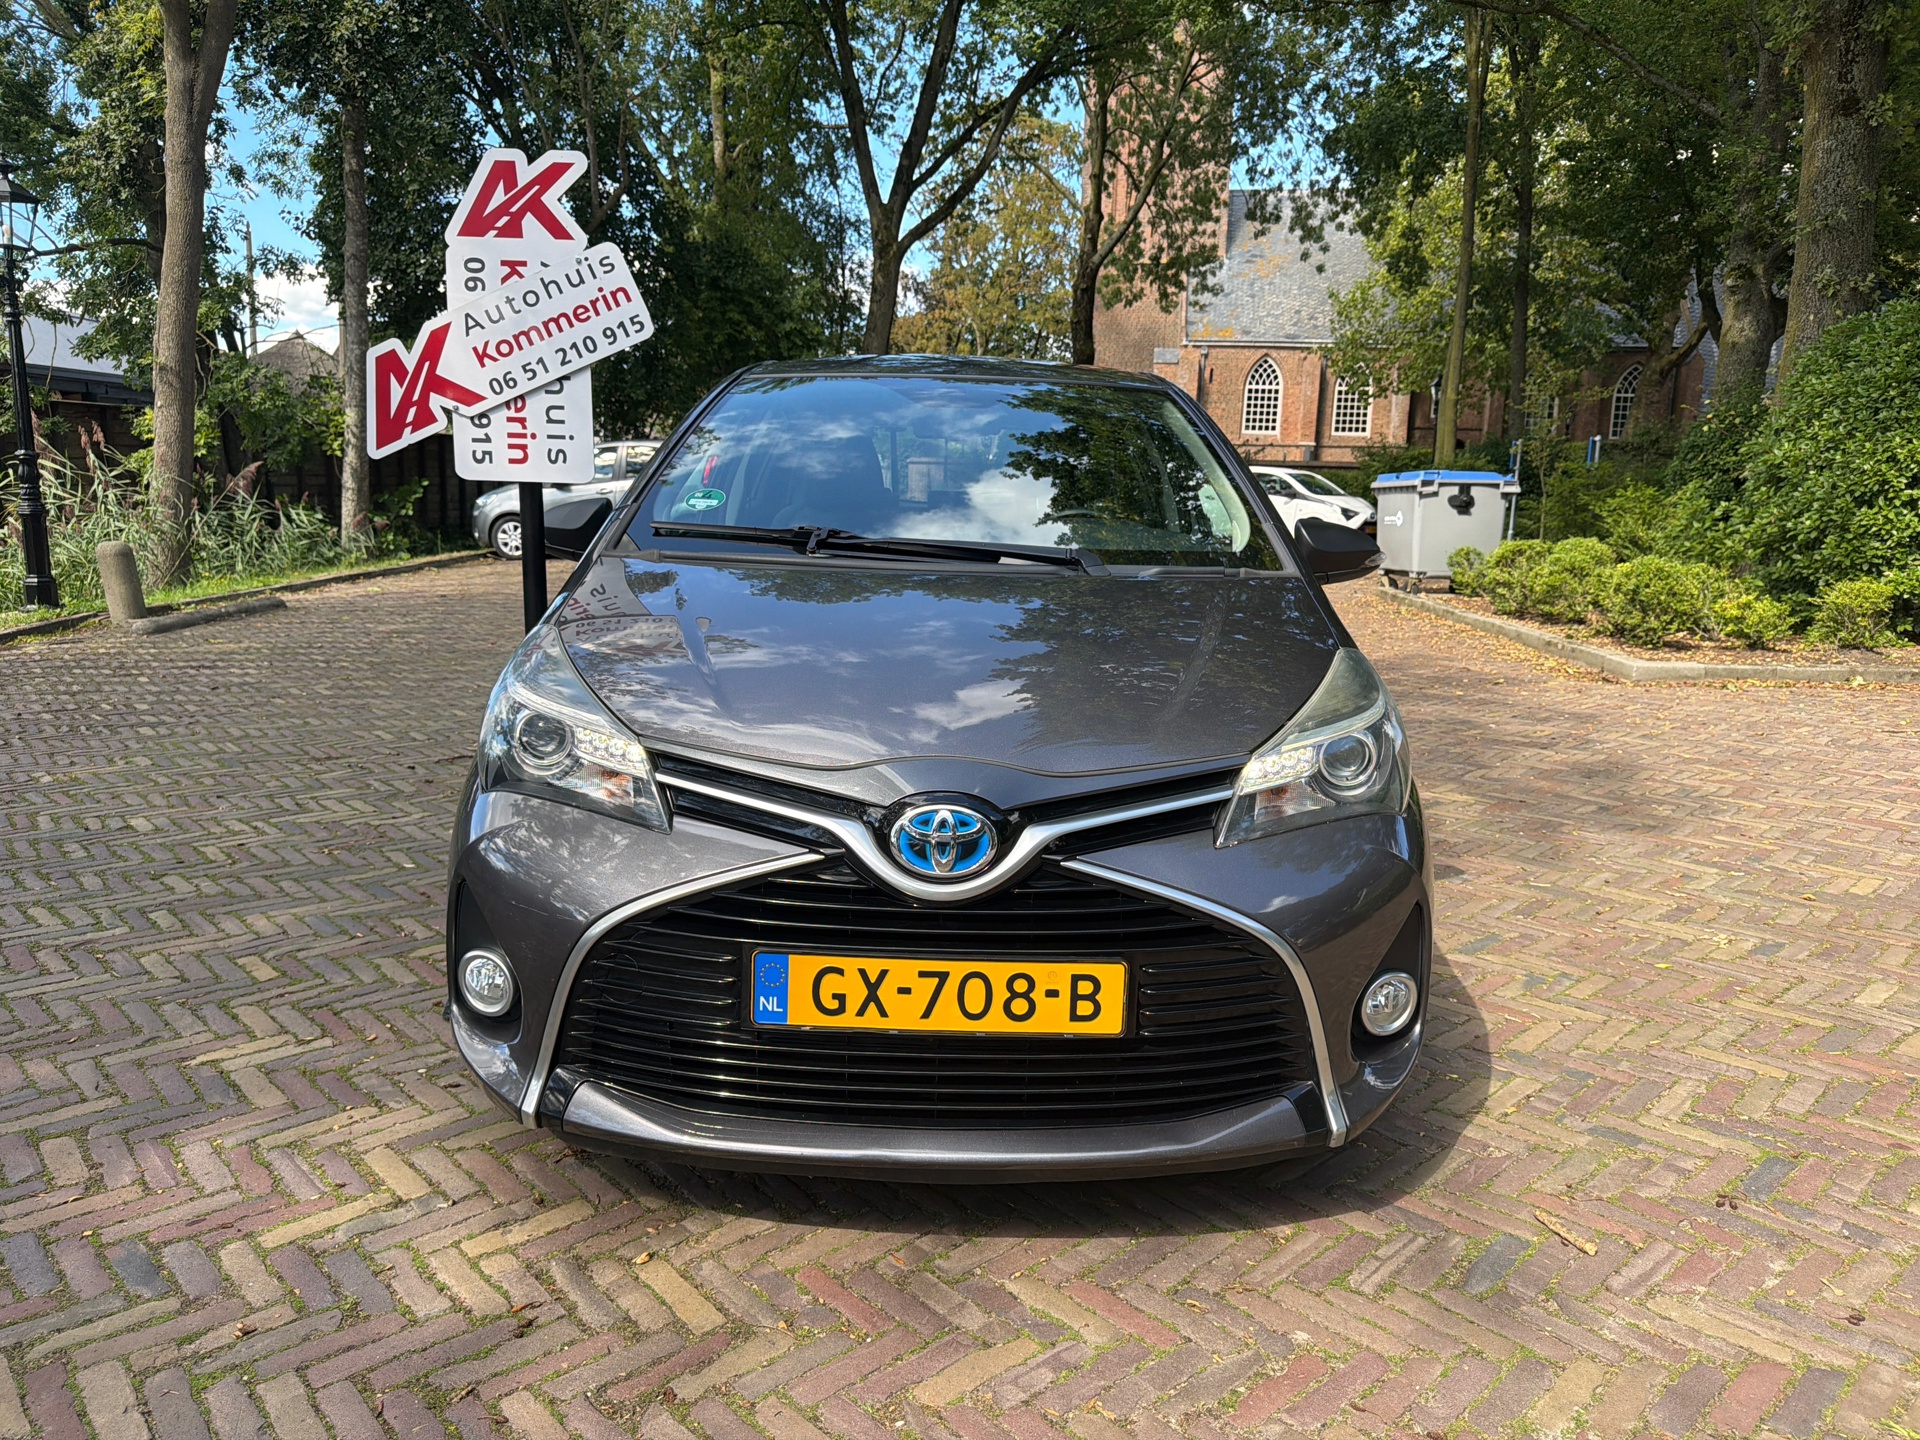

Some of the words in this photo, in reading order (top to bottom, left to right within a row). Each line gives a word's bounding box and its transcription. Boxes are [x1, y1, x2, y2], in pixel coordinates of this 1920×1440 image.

[464, 257, 486, 292] 06
[464, 255, 616, 337] Autohuis
[471, 286, 633, 369] Kommerin
[488, 370, 518, 396] 06
[521, 356, 550, 381] 51
[554, 335, 598, 367] 210
[602, 313, 645, 346] 915
[470, 413, 493, 464] 915
[759, 995, 783, 1012] NL
[812, 966, 1101, 1022] GX-708-B
